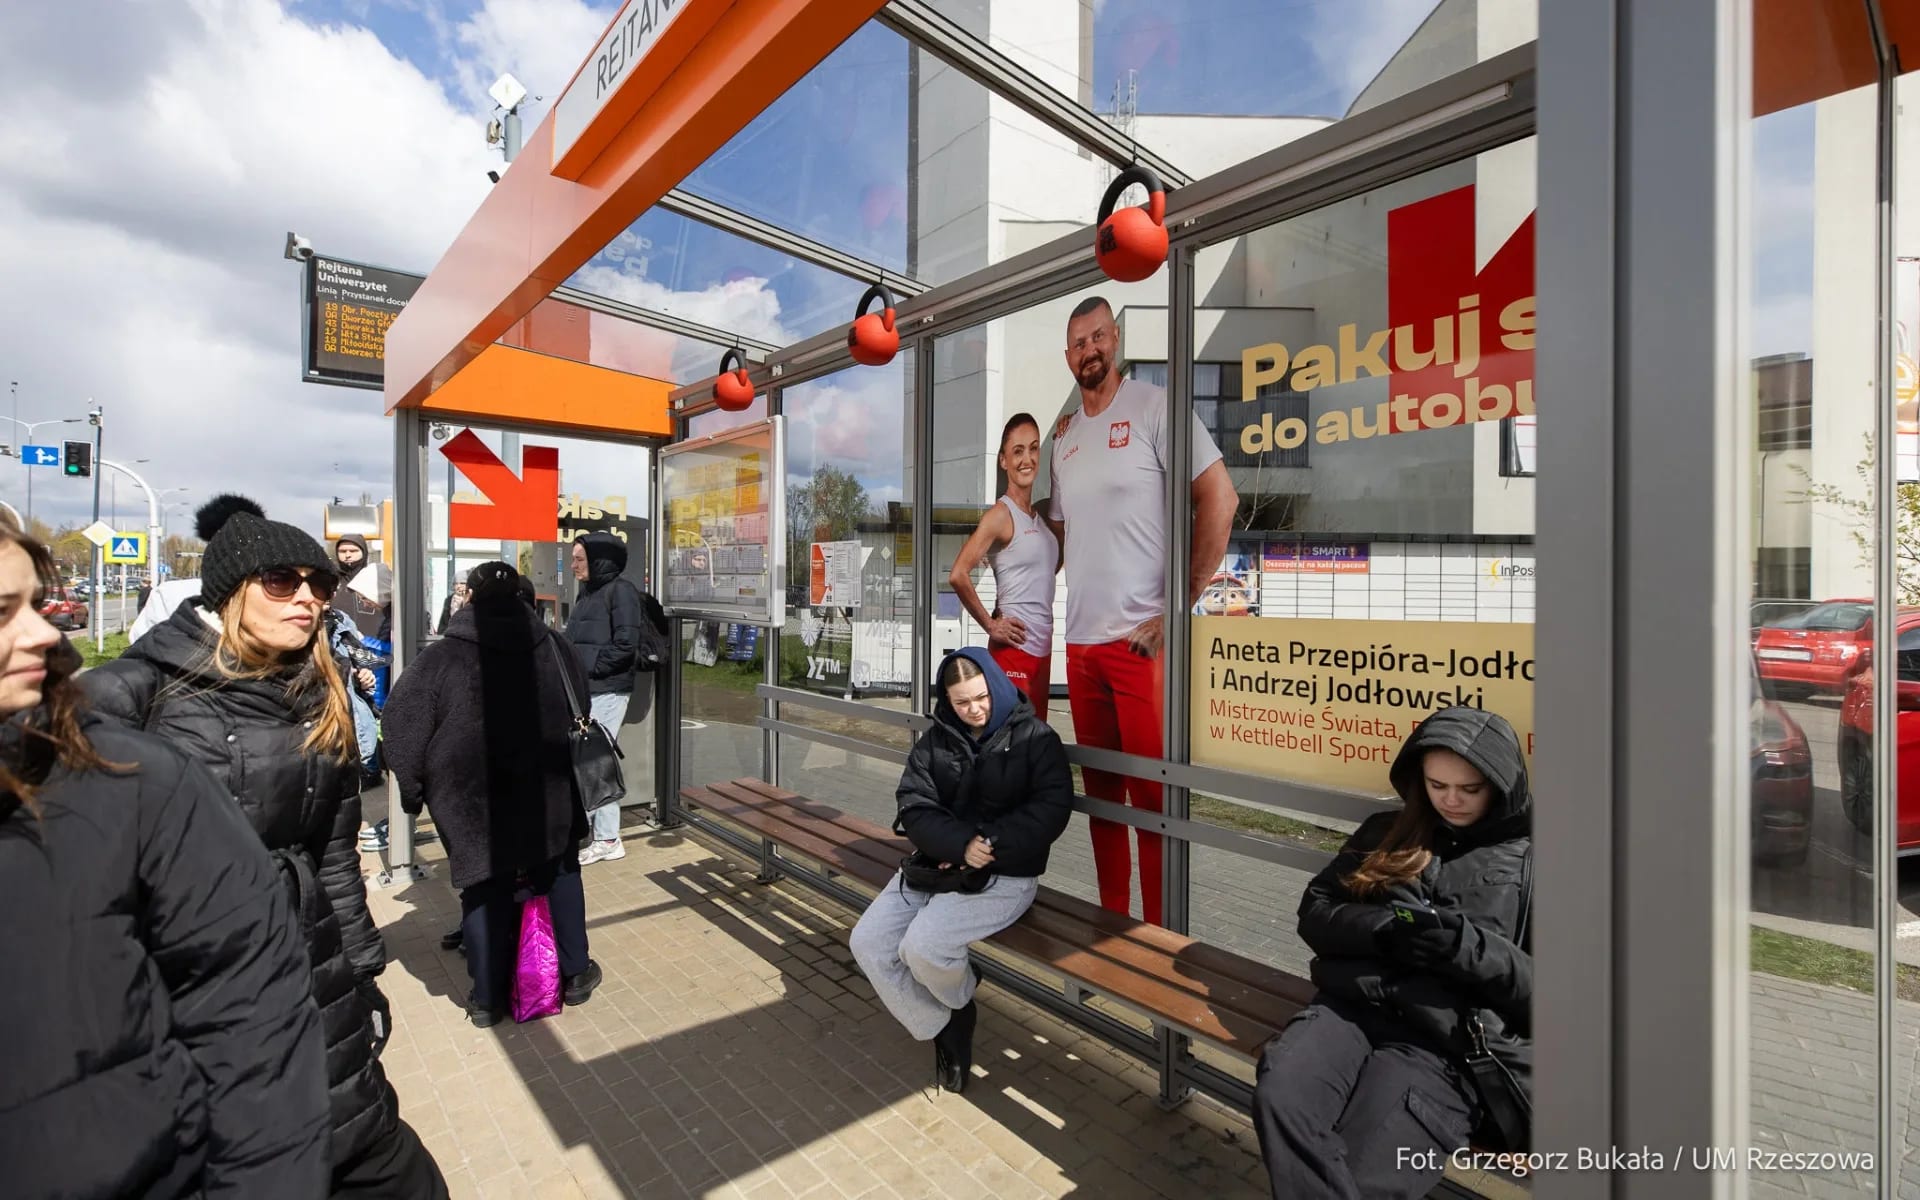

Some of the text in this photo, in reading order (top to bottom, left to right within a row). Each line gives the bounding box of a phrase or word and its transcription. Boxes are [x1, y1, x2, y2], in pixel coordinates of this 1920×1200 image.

[318, 259, 363, 276] Rejtana
[317, 285, 337, 295] Linia
[318, 271, 388, 292] Uniwersytet
[342, 289, 384, 303] Przystanek
[325, 302, 338, 311] 19
[360, 308, 389, 320] Poczty
[325, 328, 336, 336] 17
[1241, 293, 1480, 402] Pakuj
[1240, 412, 1307, 455] do
[1501, 564, 1536, 576] InPos
[1210, 637, 1280, 664] Aneta
[1210, 667, 1483, 711] i Andrzej Jodłowski
[1210, 699, 1316, 729] Mistrzowie
[1322, 706, 1402, 741] Świata,
[1210, 724, 1390, 765] w Kettlebell Sport
